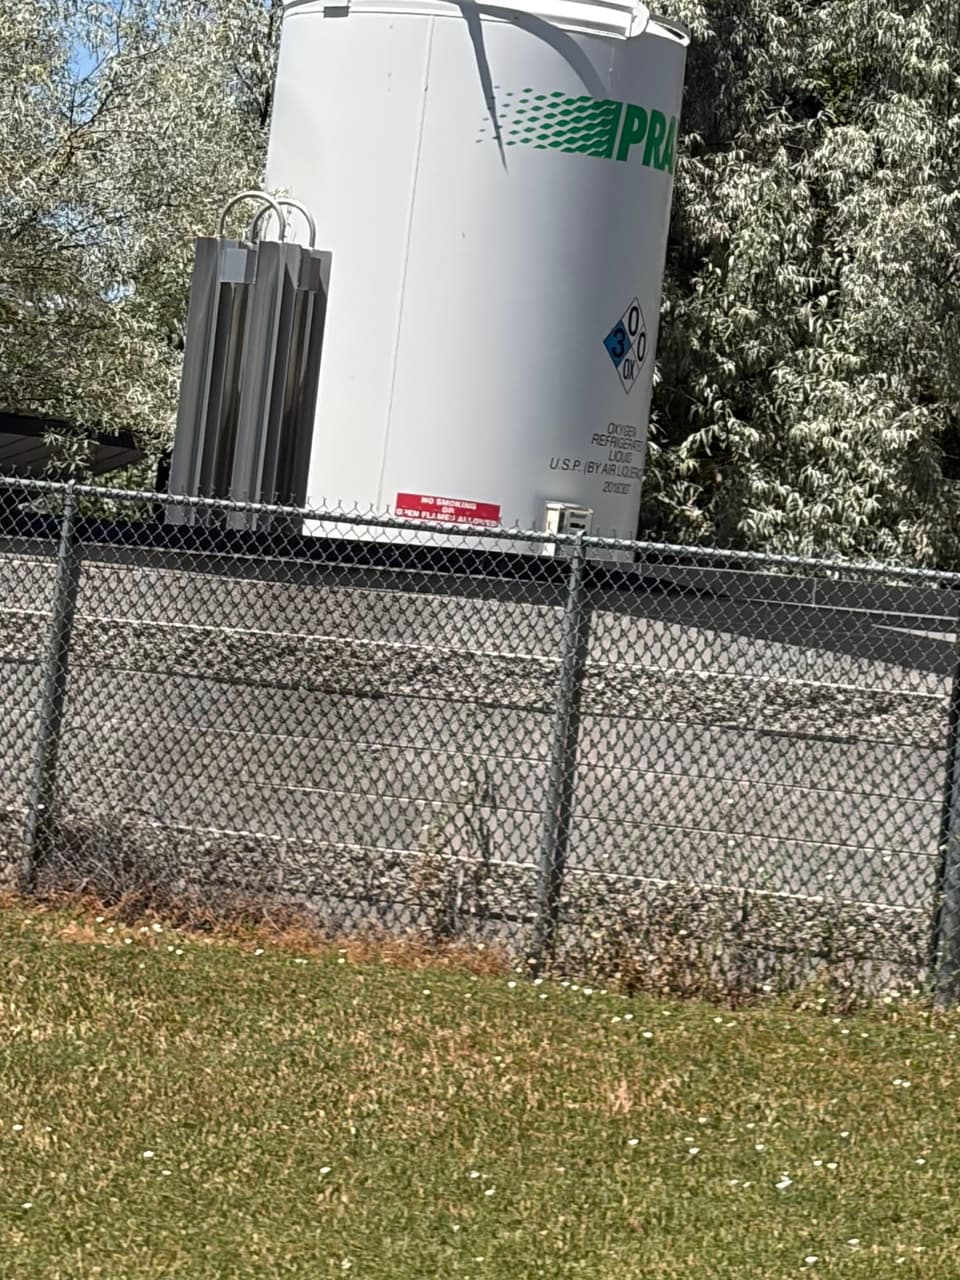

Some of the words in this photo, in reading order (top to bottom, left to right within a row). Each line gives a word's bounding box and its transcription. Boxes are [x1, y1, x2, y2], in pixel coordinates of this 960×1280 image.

[611, 327, 625, 358] 3
[421, 496, 434, 505] NO
[436, 498, 477, 510] SMOKING
